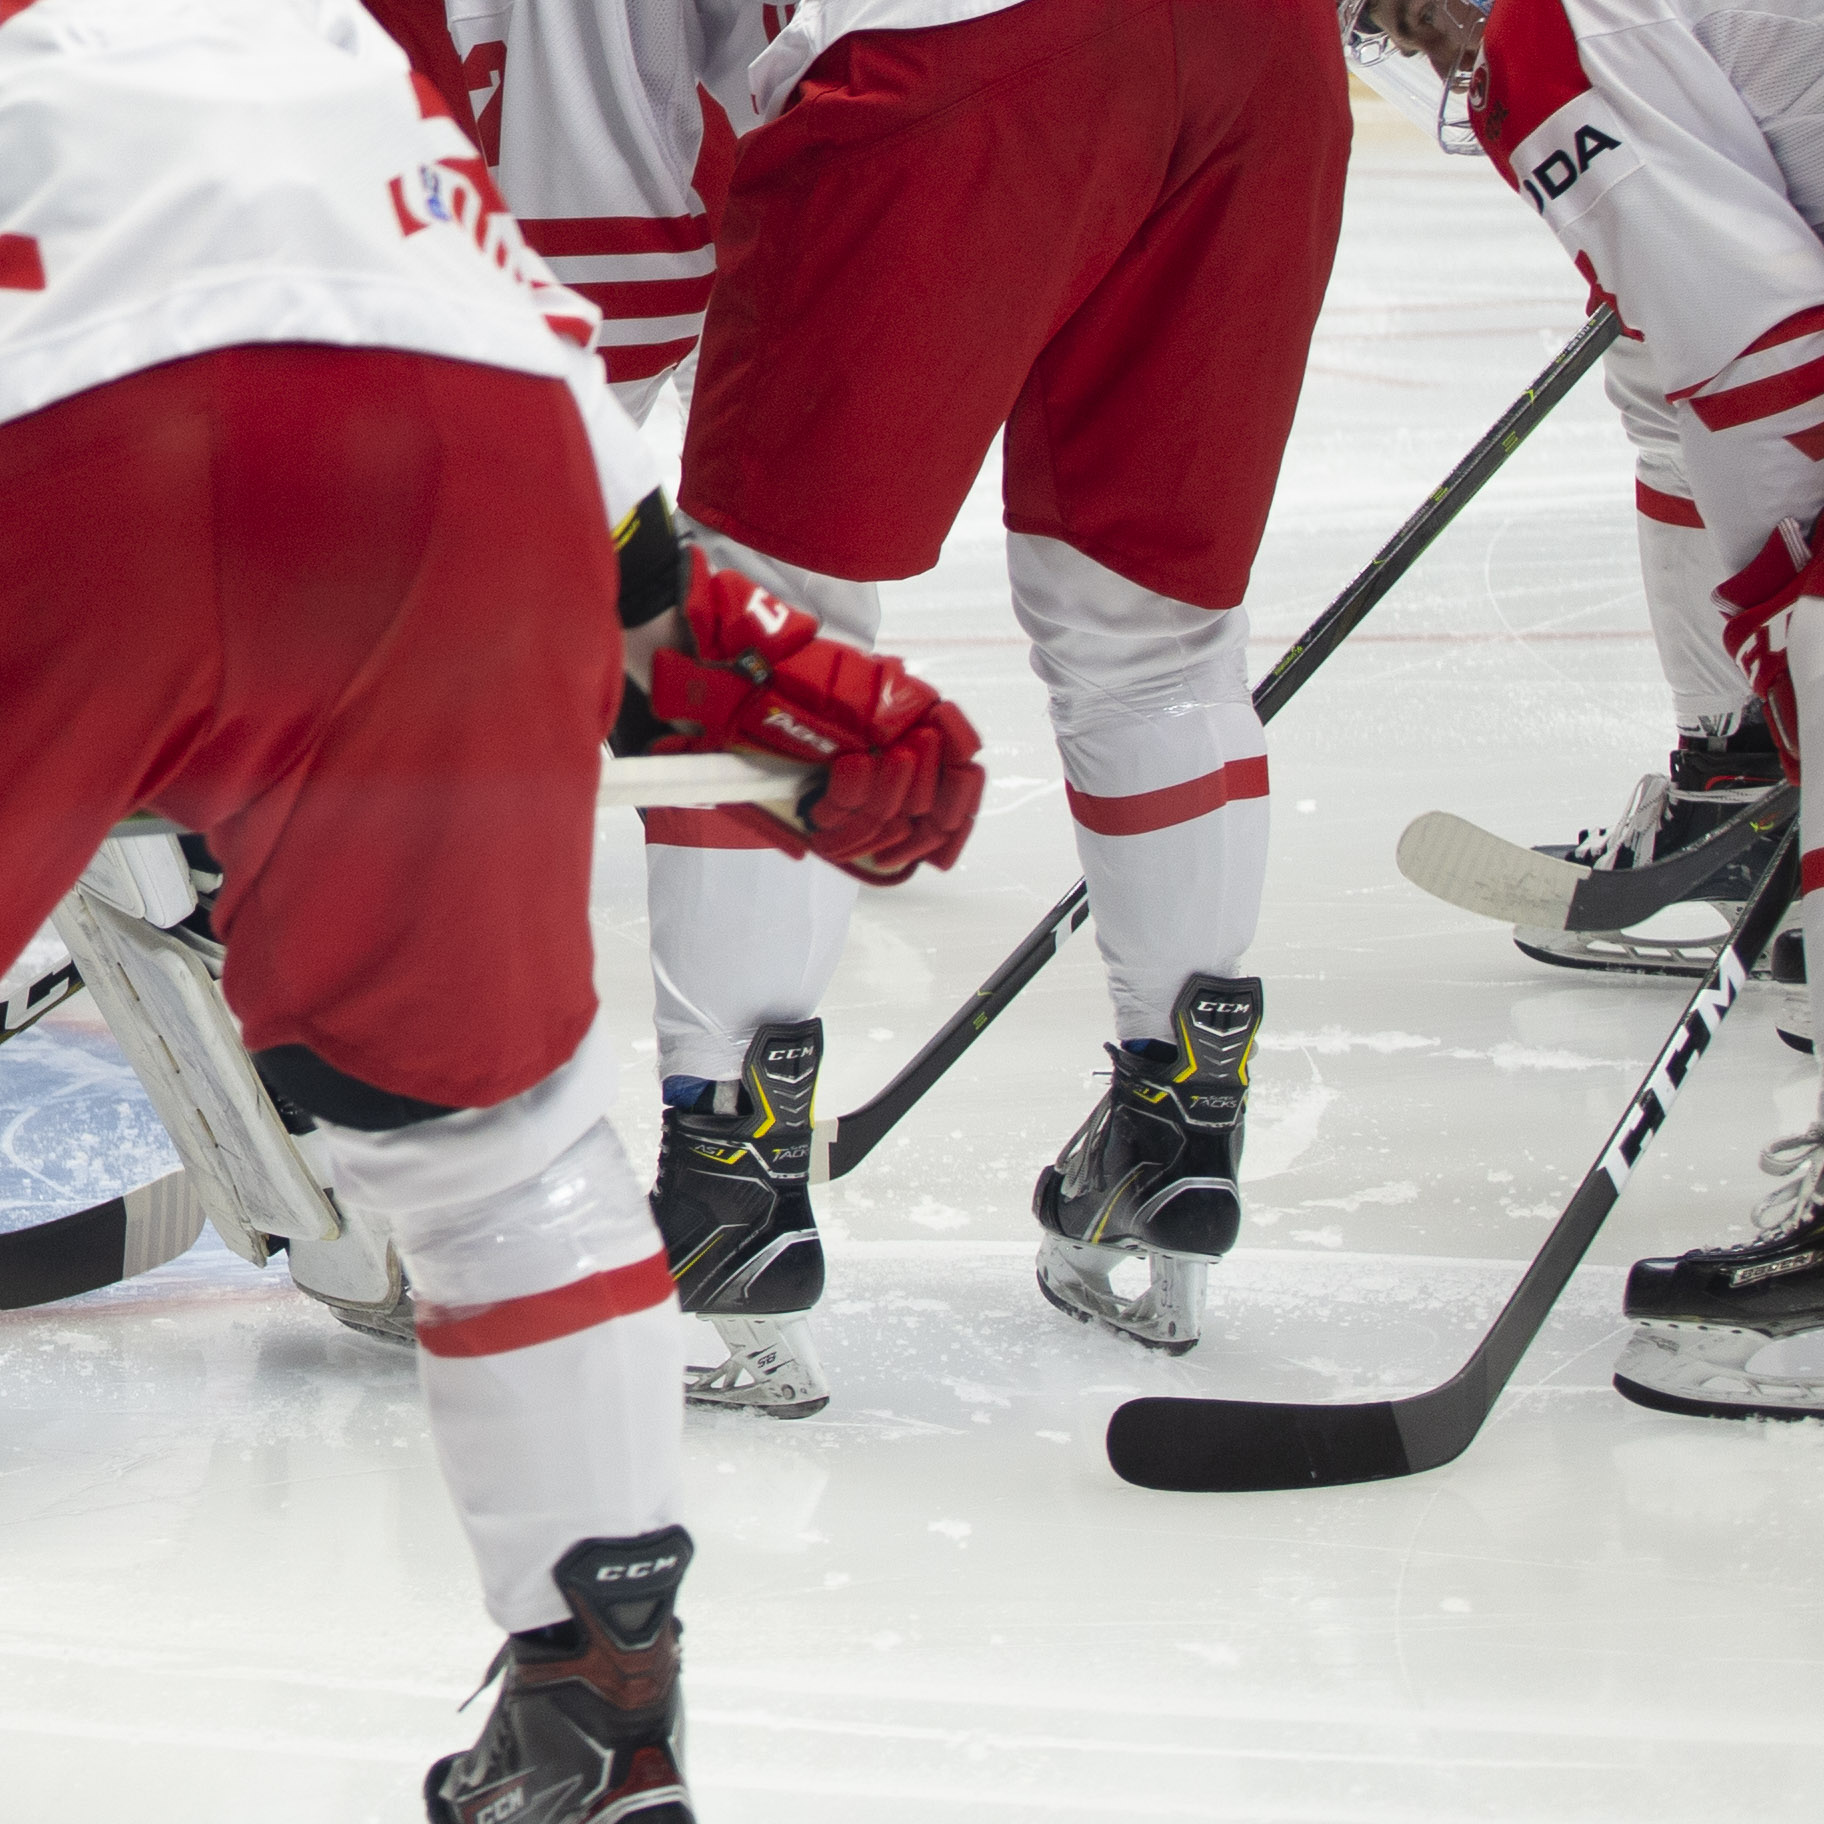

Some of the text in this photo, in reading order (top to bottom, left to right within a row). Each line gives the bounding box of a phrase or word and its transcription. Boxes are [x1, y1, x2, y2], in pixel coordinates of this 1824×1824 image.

[1197, 1000, 1251, 1014] CCM
[768, 1044, 815, 1062] CCM
[1605, 938, 1750, 1196] CCM
[596, 1555, 678, 1582] CCM
